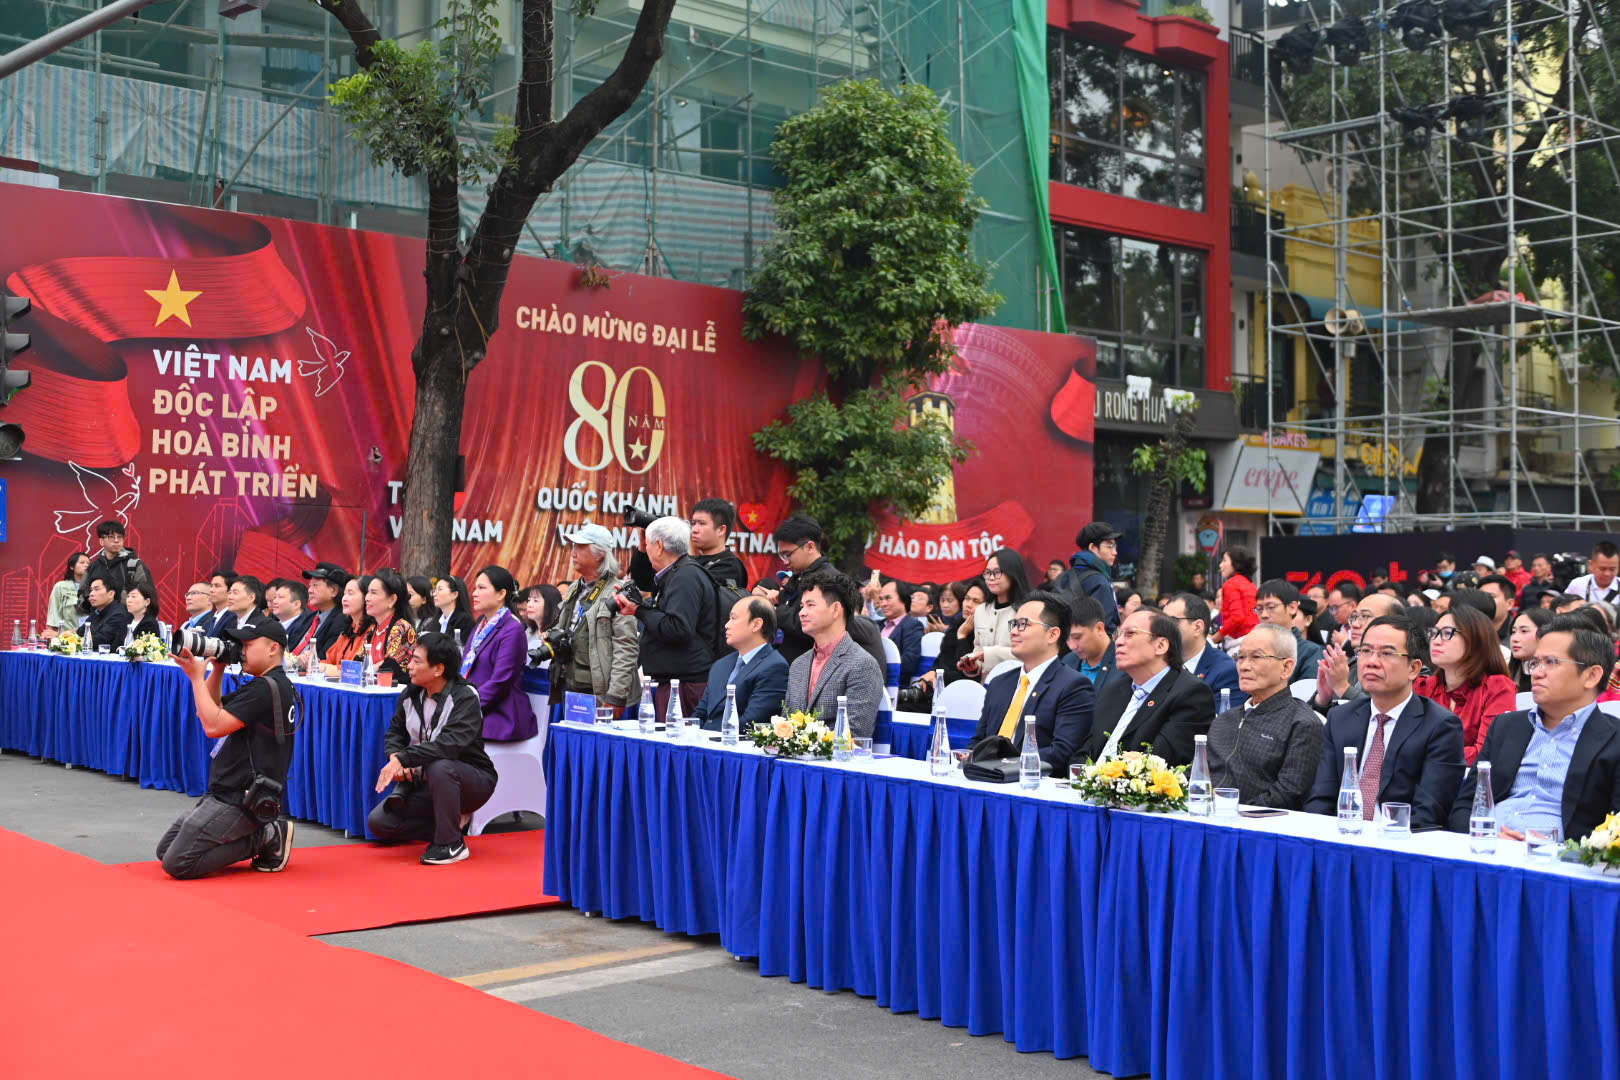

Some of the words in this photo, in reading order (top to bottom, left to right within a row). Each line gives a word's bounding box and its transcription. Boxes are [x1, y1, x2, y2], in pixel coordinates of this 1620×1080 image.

[516, 304, 577, 335] CHÀO
[582, 311, 647, 344] MỪNG
[652, 324, 687, 354] ĐẠI
[692, 320, 717, 353] LỄ
[153, 344, 221, 384] VIỆT
[228, 355, 293, 384] NAM
[152, 383, 214, 423] ĐỘC
[222, 387, 278, 426] LẬP
[563, 360, 667, 475] 80
[628, 414, 665, 429] NĂM
[1104, 391, 1138, 421] RONG
[152, 423, 214, 456] HOÀ
[221, 425, 291, 460] BÌNH
[148, 462, 227, 495] PHÁT
[233, 464, 318, 498] TRIỂN
[537, 481, 598, 512] QUỐC
[602, 487, 678, 516] KHÁNH
[451, 517, 503, 543] NAM
[879, 531, 920, 559] HÀO
[924, 535, 965, 561] DÂN
[968, 531, 1005, 560] TỘC
